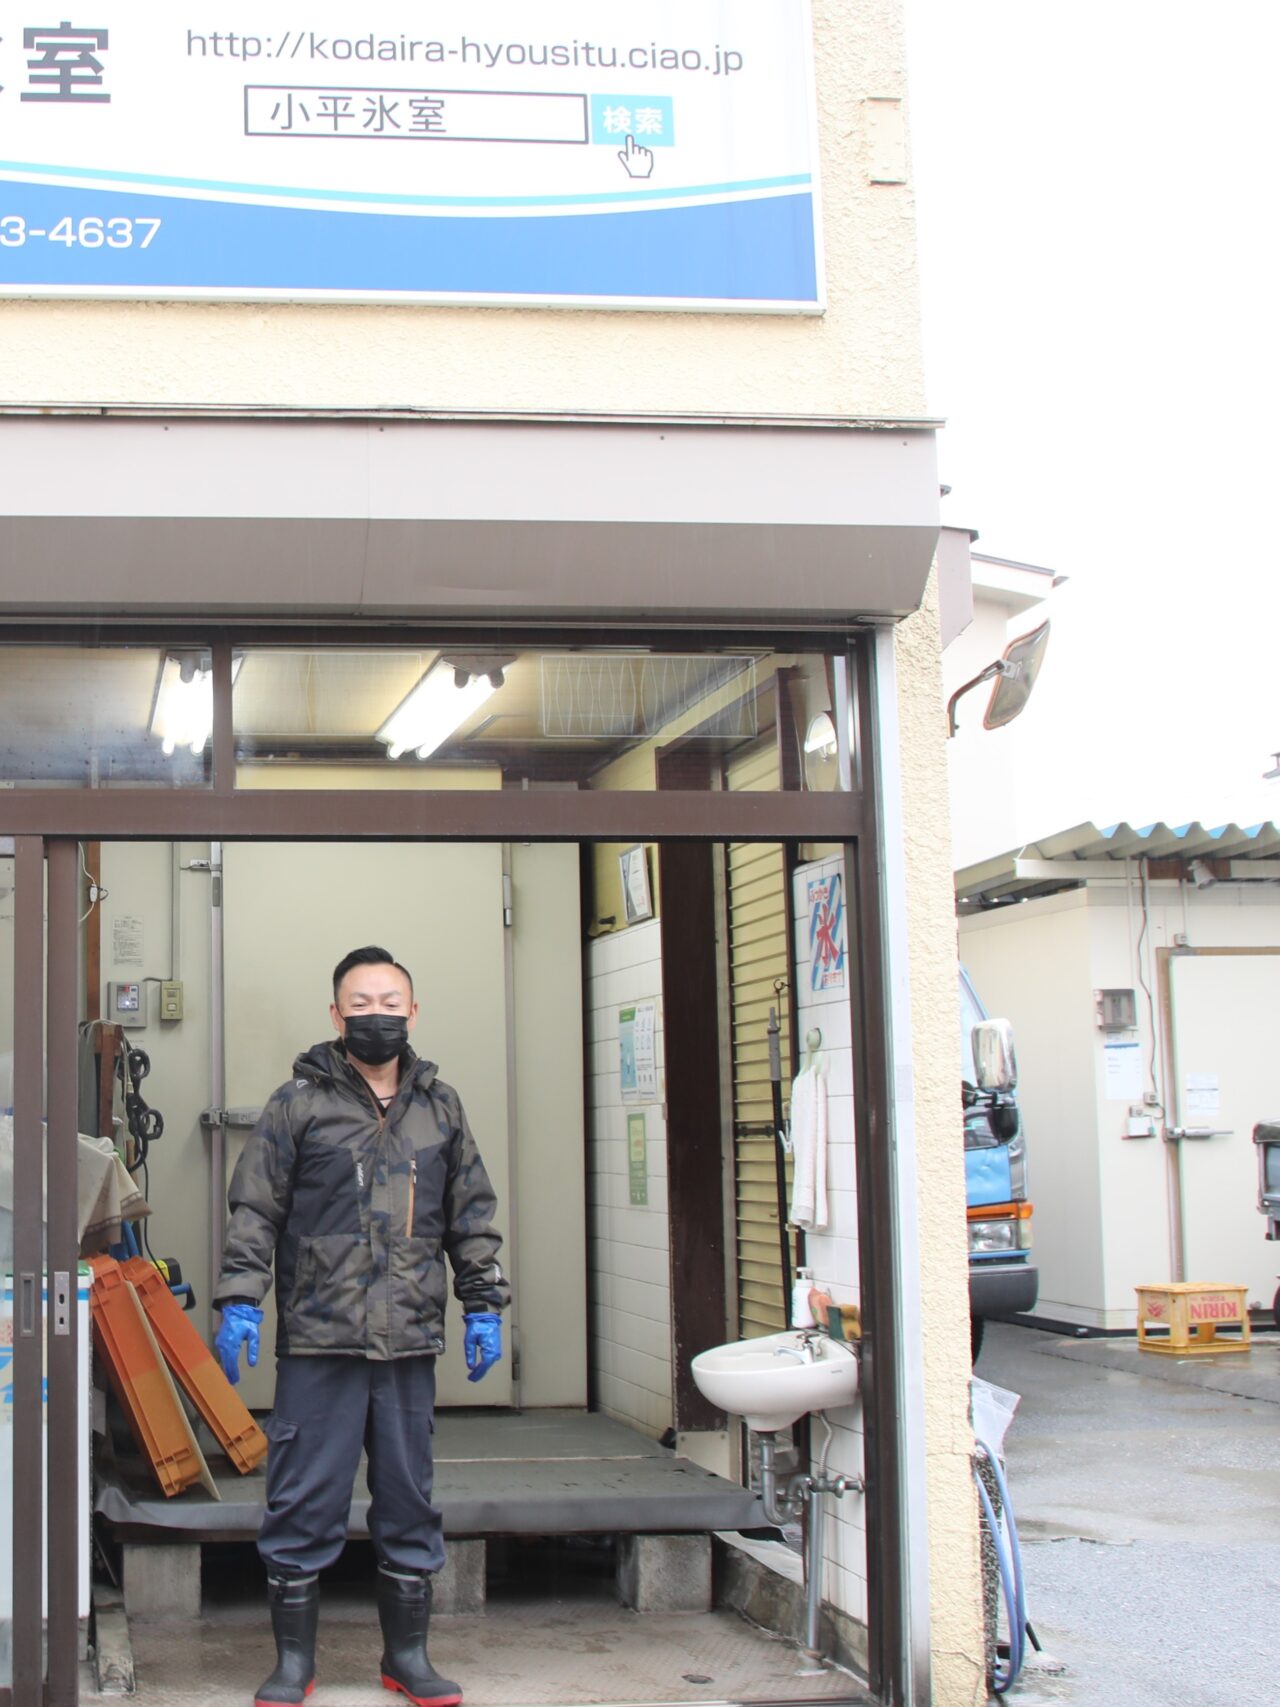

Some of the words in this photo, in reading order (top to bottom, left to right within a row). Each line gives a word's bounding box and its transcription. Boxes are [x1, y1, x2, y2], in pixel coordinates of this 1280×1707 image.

[187, 29, 744, 76] http://kodaira-hyousitu.ciao.jp
[270, 93, 447, 133] 小平氷室
[602, 105, 663, 135] 検索
[1190, 1301, 1237, 1319] KIRIN
